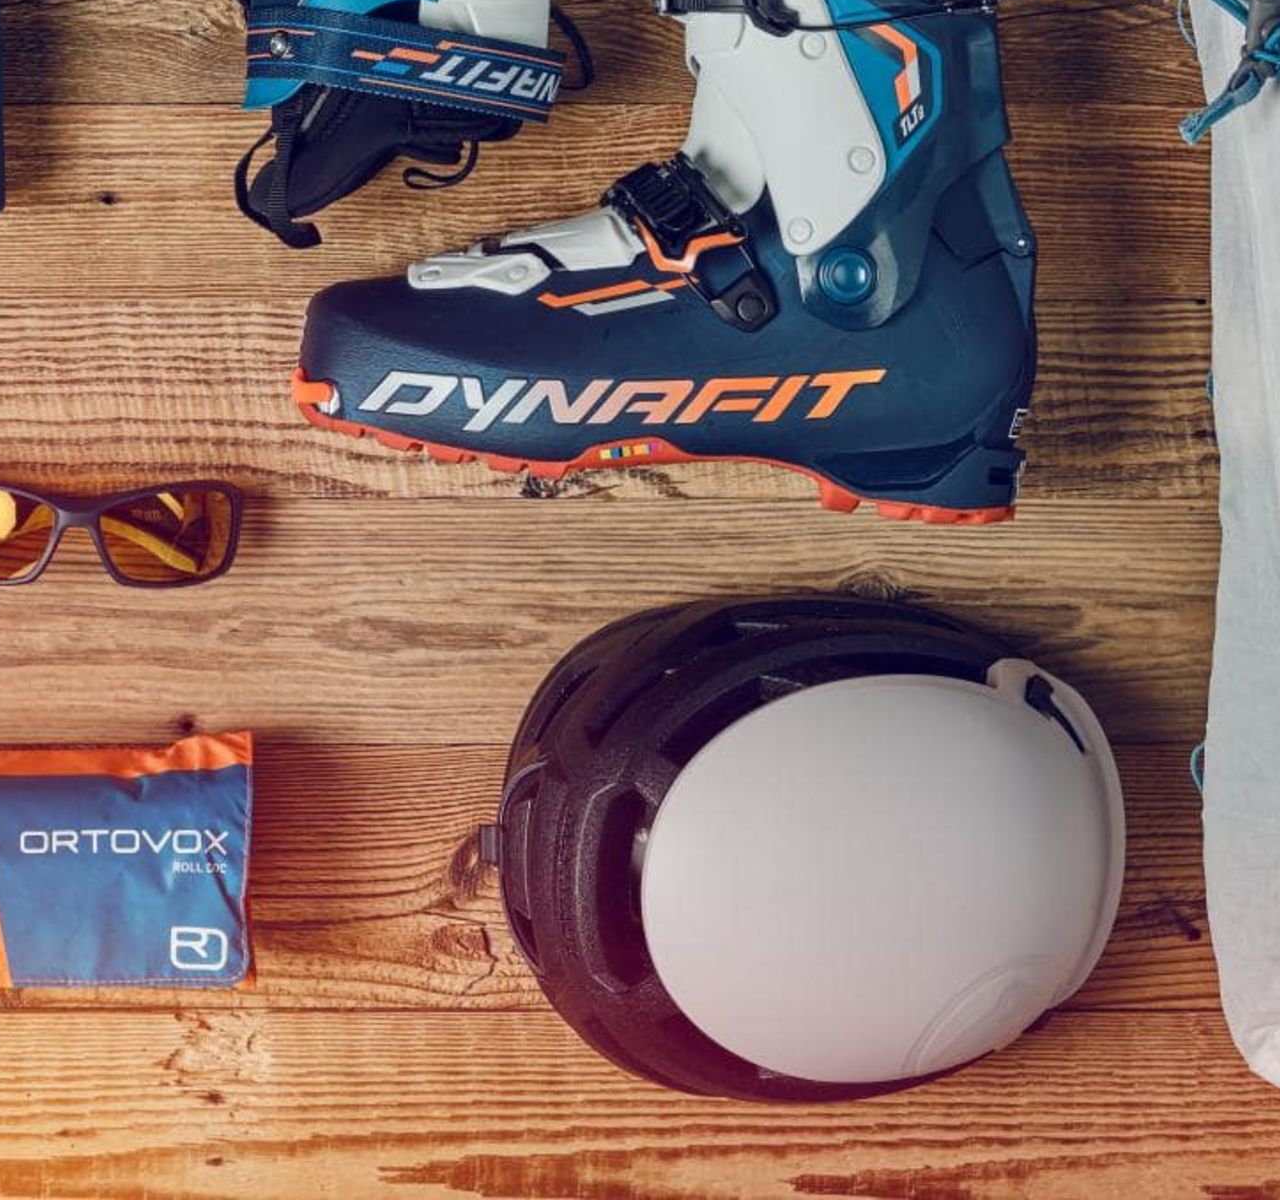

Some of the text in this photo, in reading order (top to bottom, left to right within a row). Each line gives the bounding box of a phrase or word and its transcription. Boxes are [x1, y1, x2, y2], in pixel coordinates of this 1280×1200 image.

[358, 369, 886, 433] DYNAFIT
[20, 829, 228, 856] ORTOVOX
[173, 860, 201, 873] ROLL
